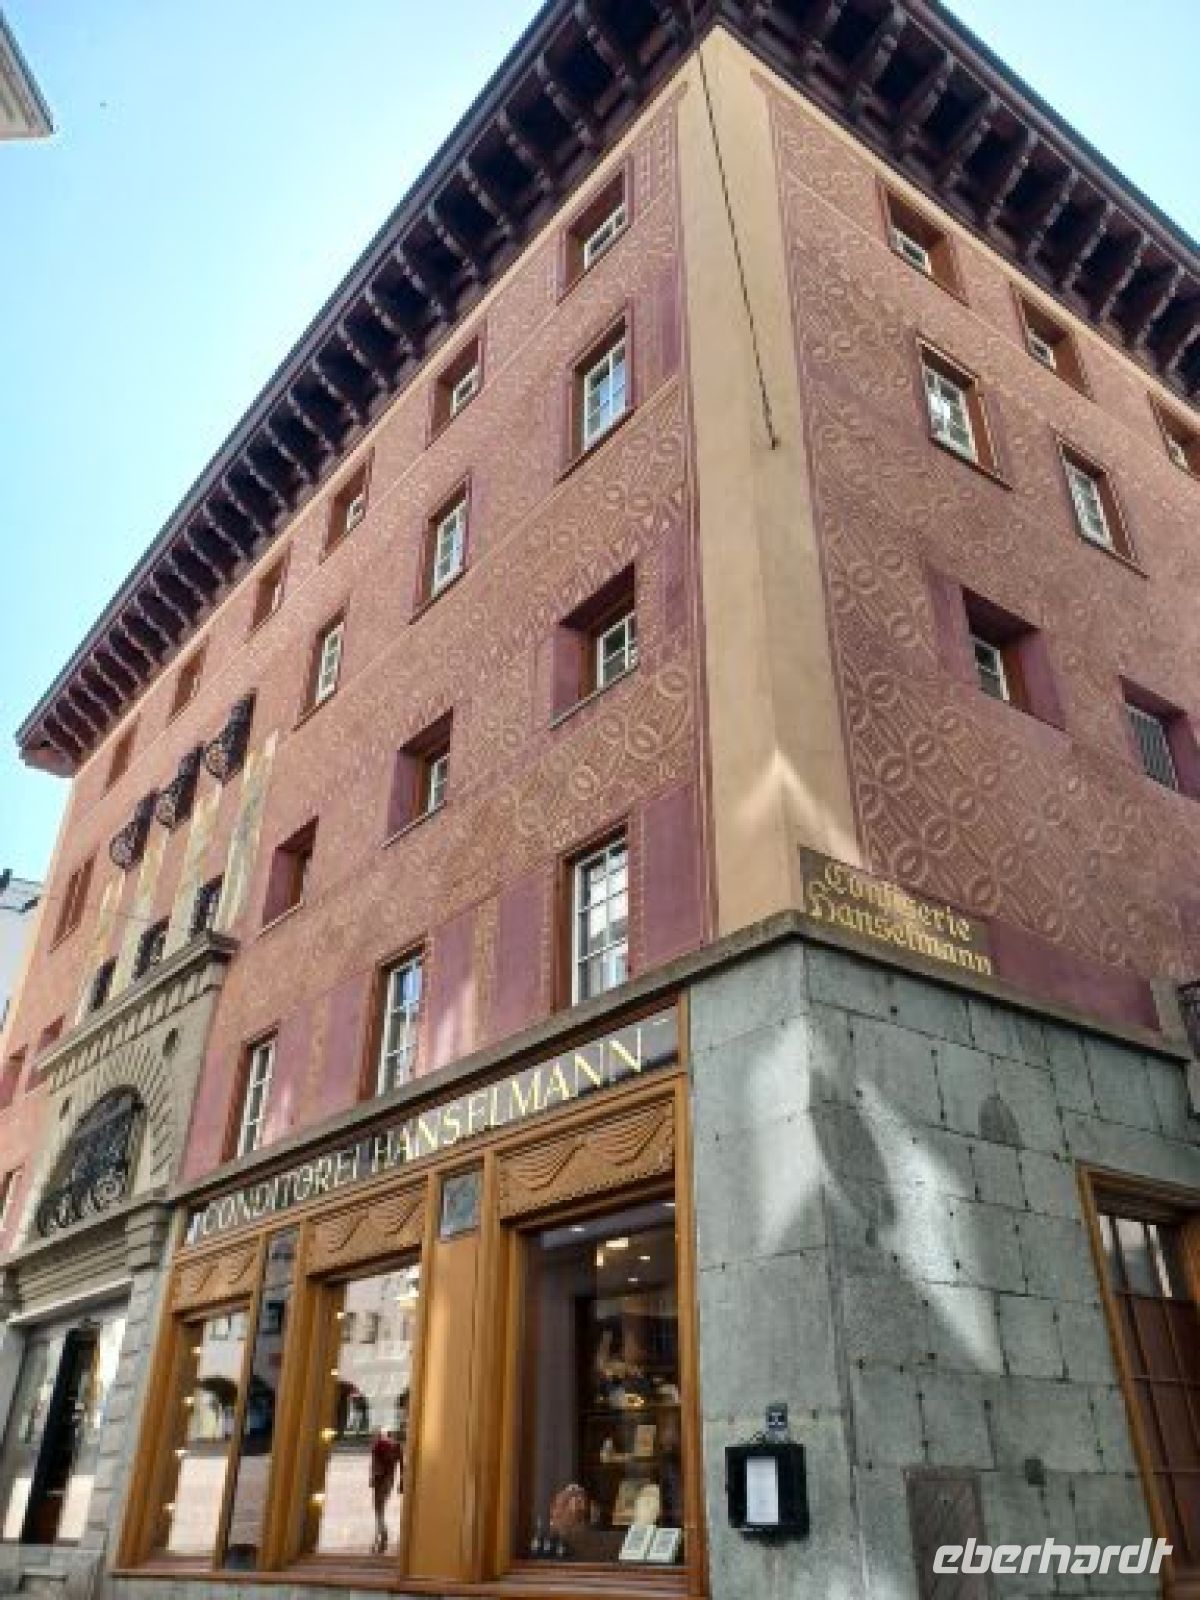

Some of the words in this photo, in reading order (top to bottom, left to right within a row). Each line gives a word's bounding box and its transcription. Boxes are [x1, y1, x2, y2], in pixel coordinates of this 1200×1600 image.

[808, 881, 992, 976] Hanselmann
[201, 1144, 360, 1238] CONDITOREI
[371, 1027, 643, 1173] HANSELMANN
